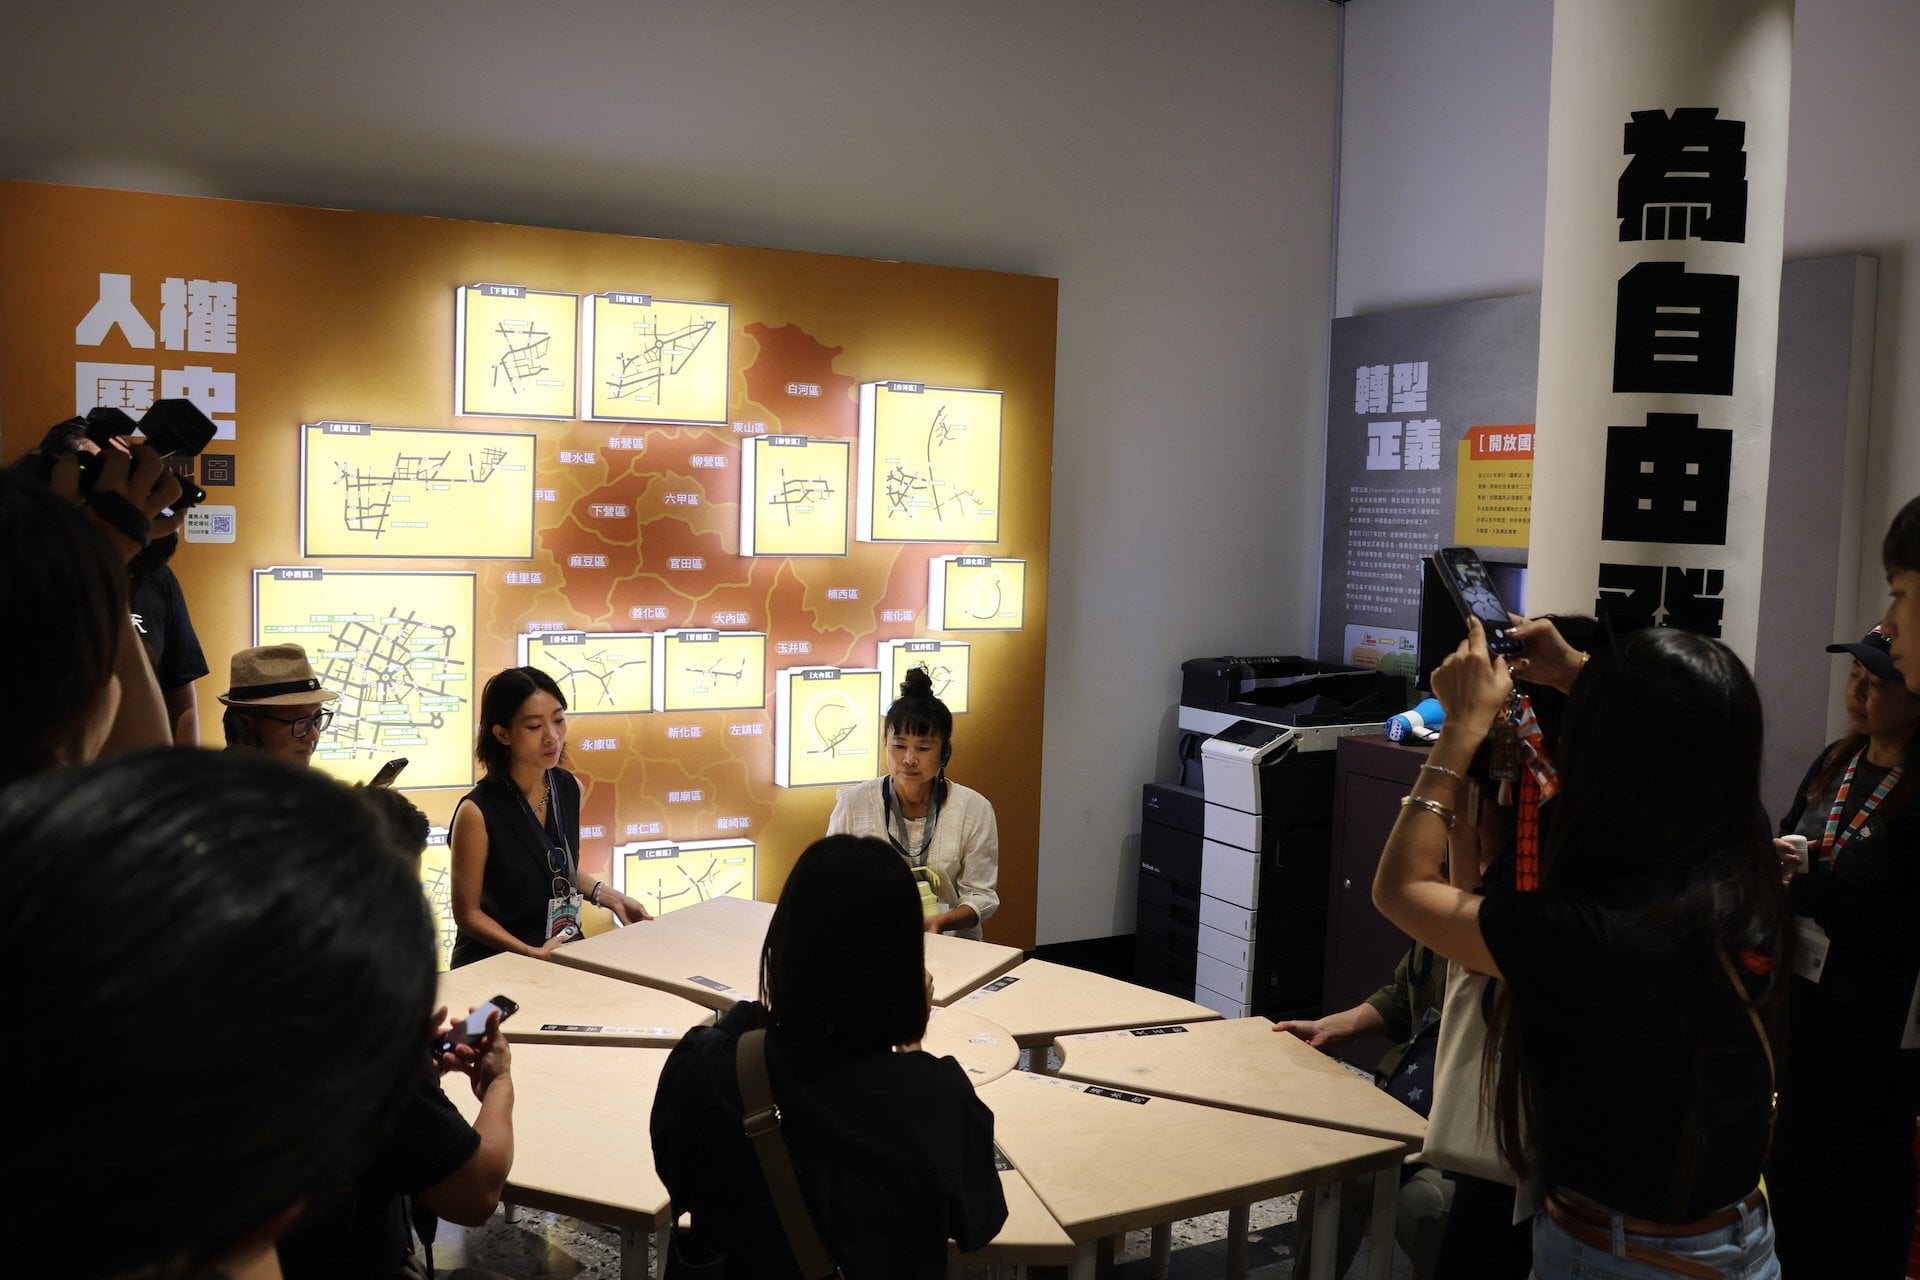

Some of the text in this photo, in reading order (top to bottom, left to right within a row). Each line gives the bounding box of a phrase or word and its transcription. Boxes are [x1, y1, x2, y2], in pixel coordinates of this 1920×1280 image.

[75, 273, 237, 353] 人權
[787, 384, 820, 396] 白河區
[1355, 361, 1429, 415] 轉型
[733, 422, 767, 434] 東山區
[608, 437, 644, 449] 新營區
[1366, 418, 1441, 471] 正義
[559, 452, 596, 464] 鹽水區
[691, 455, 726, 468] 柳營區
[535, 490, 556, 502] 甲區
[664, 493, 698, 505] 六甲區
[592, 505, 626, 517] 下營區
[570, 555, 606, 567] 麻豆區
[670, 558, 703, 569] 官田區
[506, 572, 543, 584] 佳里區
[827, 589, 858, 600] 楠西區
[631, 607, 667, 619] 善化區
[714, 613, 748, 625] 大內區
[883, 611, 914, 622] 南化區
[778, 642, 809, 654] 玉井區
[667, 726, 702, 738] 新化區
[730, 724, 764, 736] 左鎮區
[582, 739, 617, 750] 永康區
[668, 791, 703, 803] 關廟區
[626, 823, 661, 836] 歸仁區
[717, 818, 750, 830] 龍崎區
